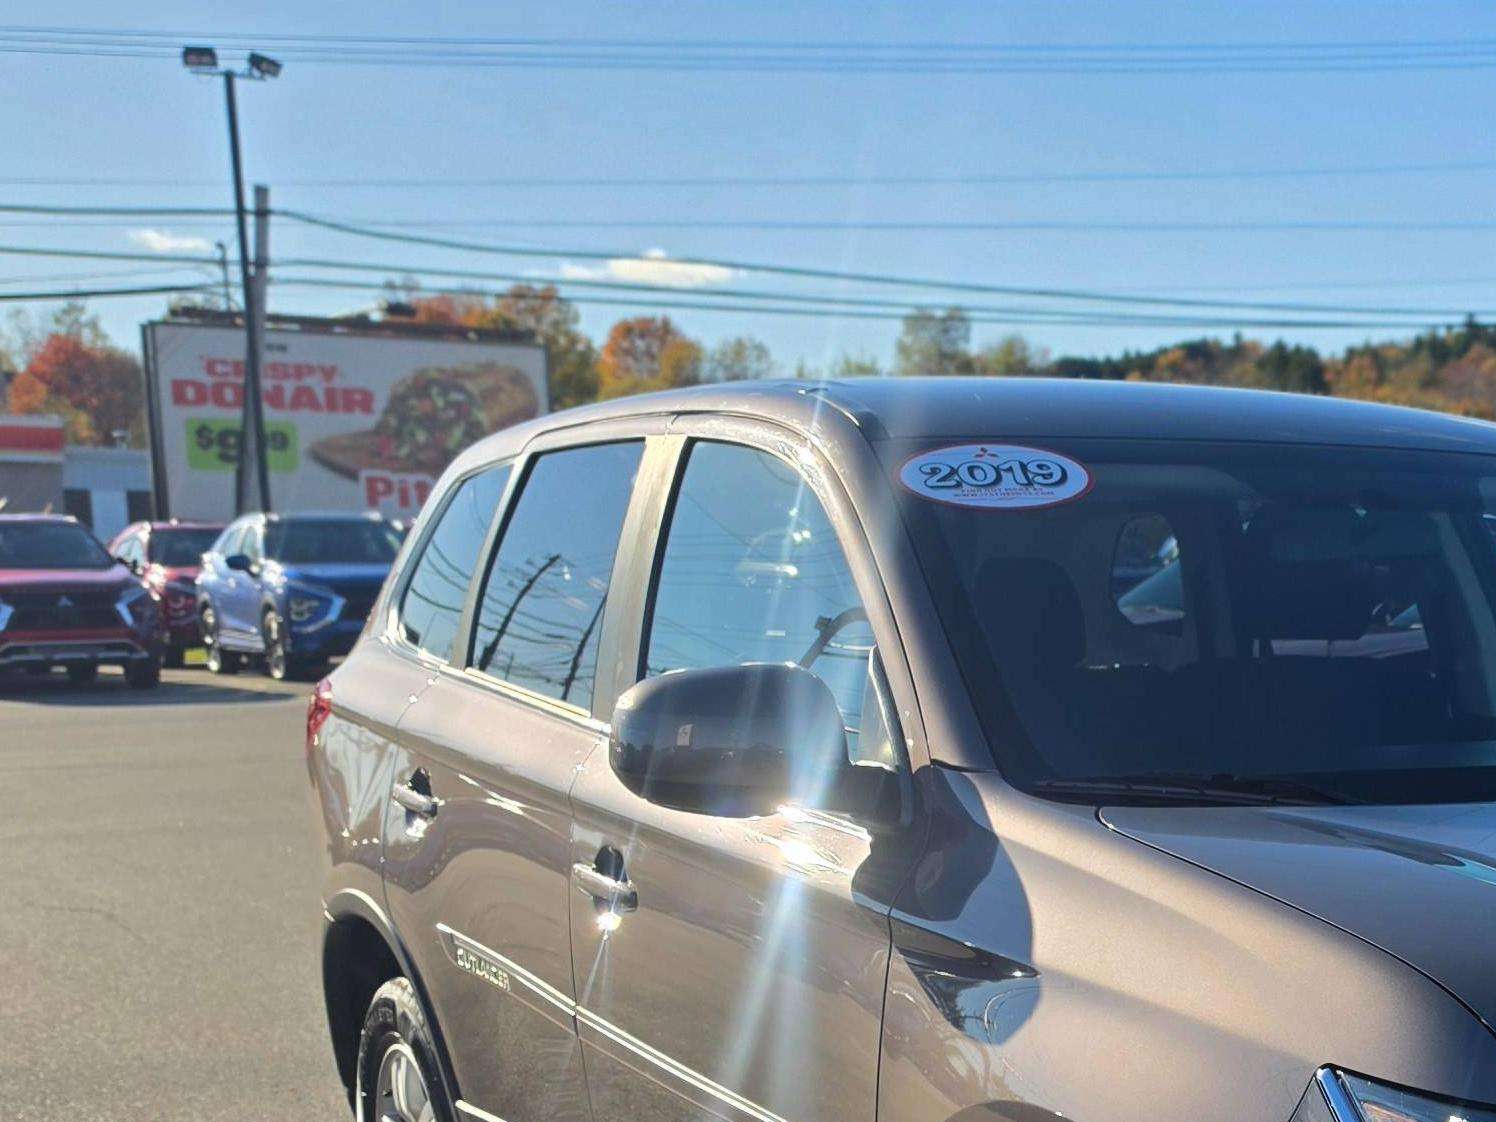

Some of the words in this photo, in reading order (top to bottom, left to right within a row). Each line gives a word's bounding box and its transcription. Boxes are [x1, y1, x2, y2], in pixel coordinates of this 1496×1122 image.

[205, 357, 337, 382] CRSPY
[918, 459, 1069, 489] 2019
[365, 475, 433, 509] Pit
